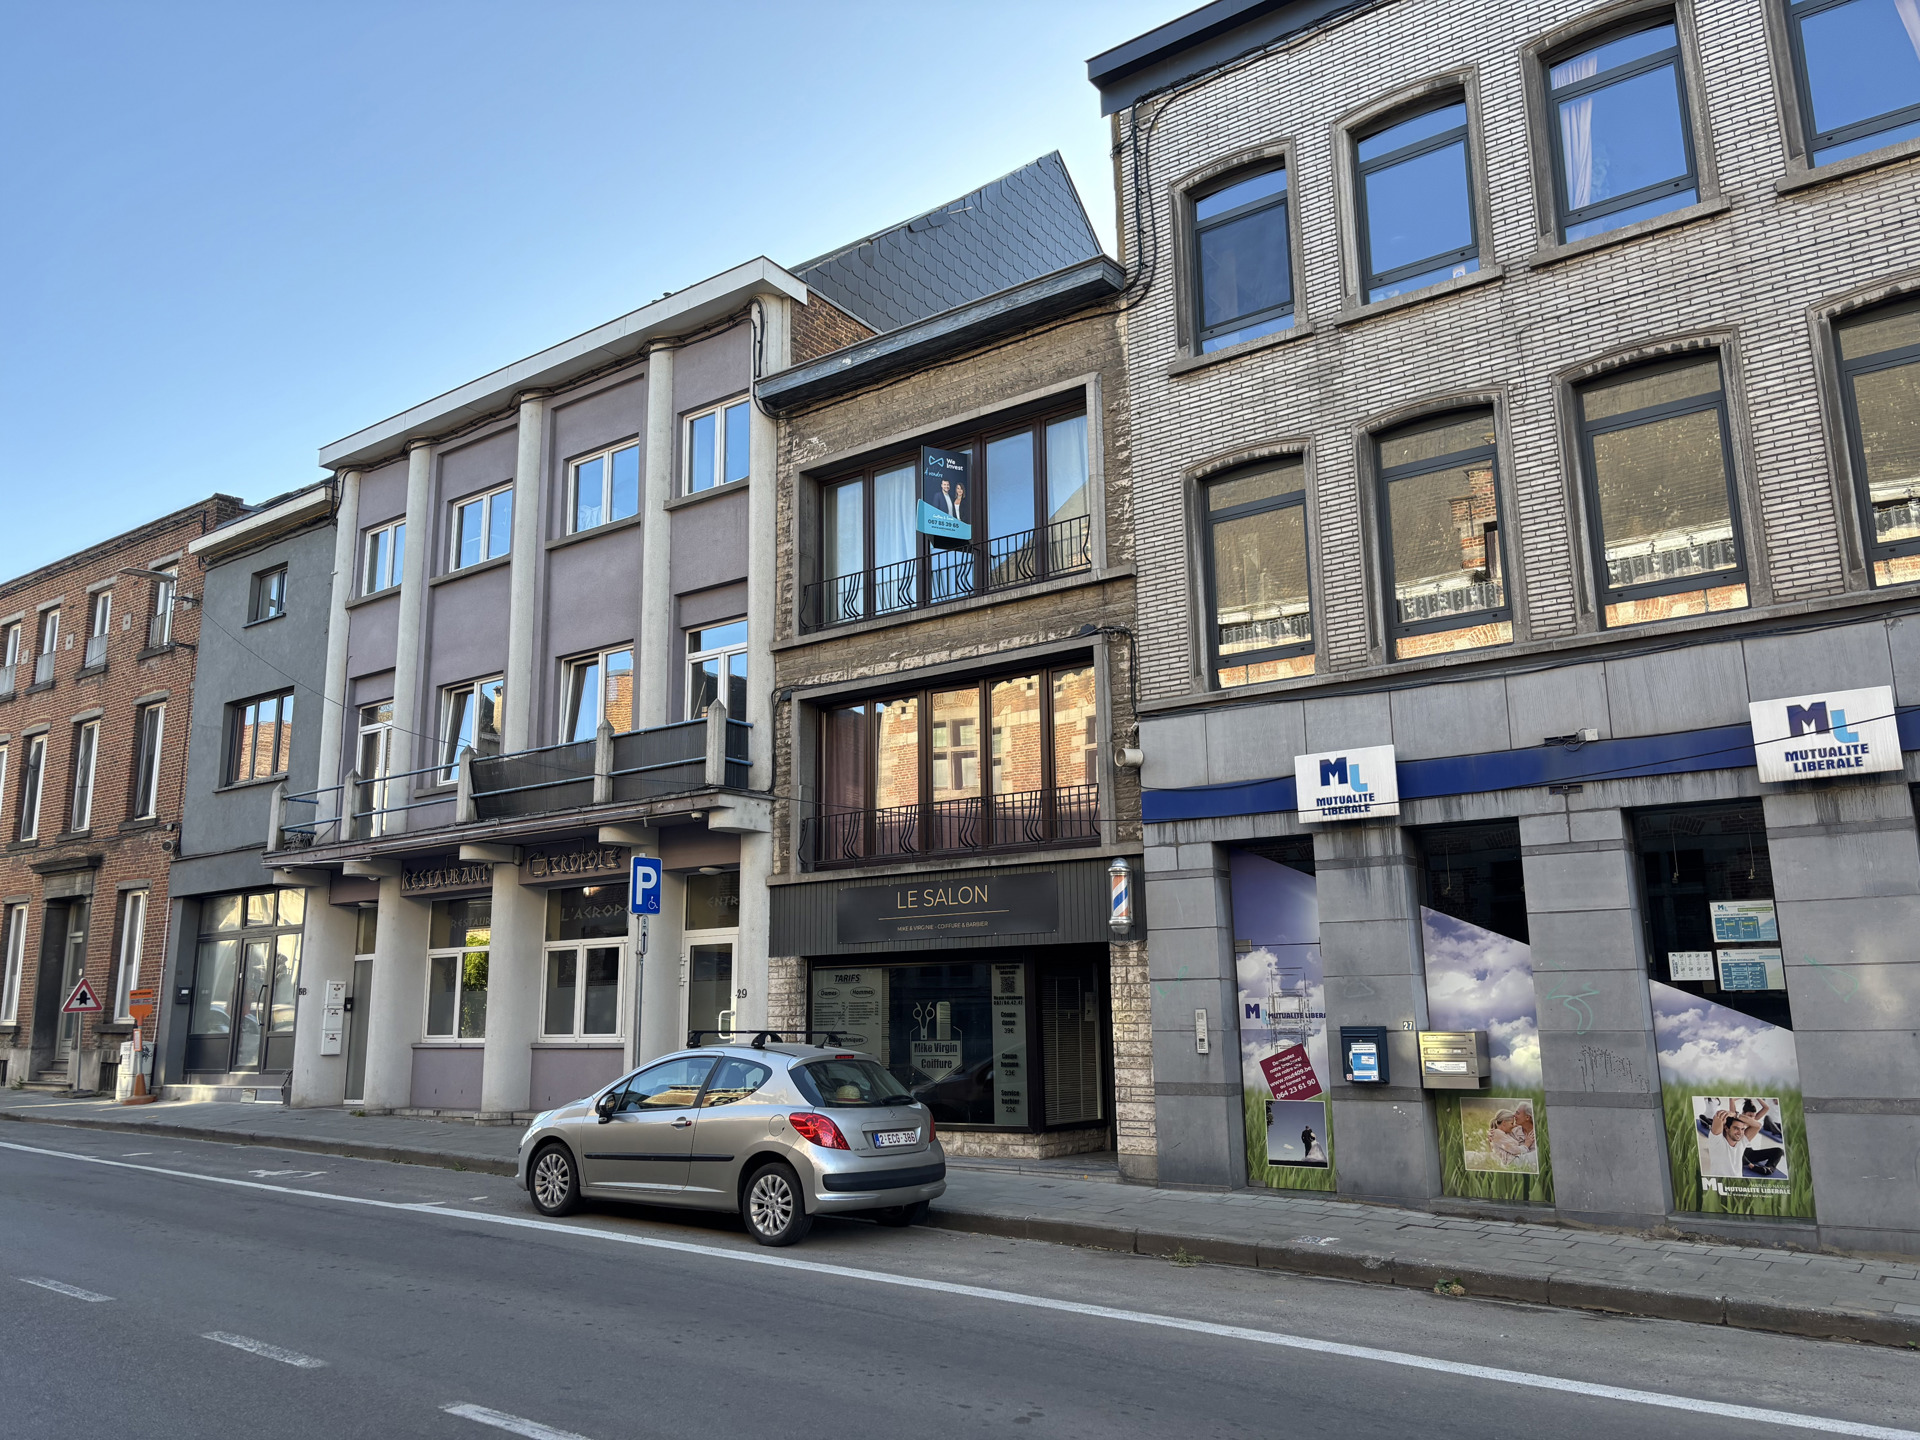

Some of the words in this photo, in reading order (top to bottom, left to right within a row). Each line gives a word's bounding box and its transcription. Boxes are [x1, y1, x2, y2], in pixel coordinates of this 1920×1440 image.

[1784, 743, 1870, 762] MUTUALITE
[1793, 756, 1864, 773] LIBERALE
[1316, 793, 1375, 807] MUTUALITE
[1322, 804, 1371, 816] LIBERALE
[402, 863, 489, 890] RESTAURANT
[635, 866, 658, 905] P
[897, 890, 918, 909] LE
[923, 885, 988, 907] SALON
[834, 974, 860, 982] TARIFS
[737, 988, 748, 999] 29
[1403, 1022, 1414, 1031] 27
[914, 1043, 933, 1053] Mike
[934, 1043, 958, 1054] Virgin
[921, 1059, 953, 1069] Coiffure
[1276, 1090, 1289, 1100] 064
[1289, 1086, 1298, 1095] 23
[1298, 1082, 1307, 1091] 61
[1307, 1078, 1316, 1087] 90
[1725, 1186, 1760, 1194] MUTUALITE
